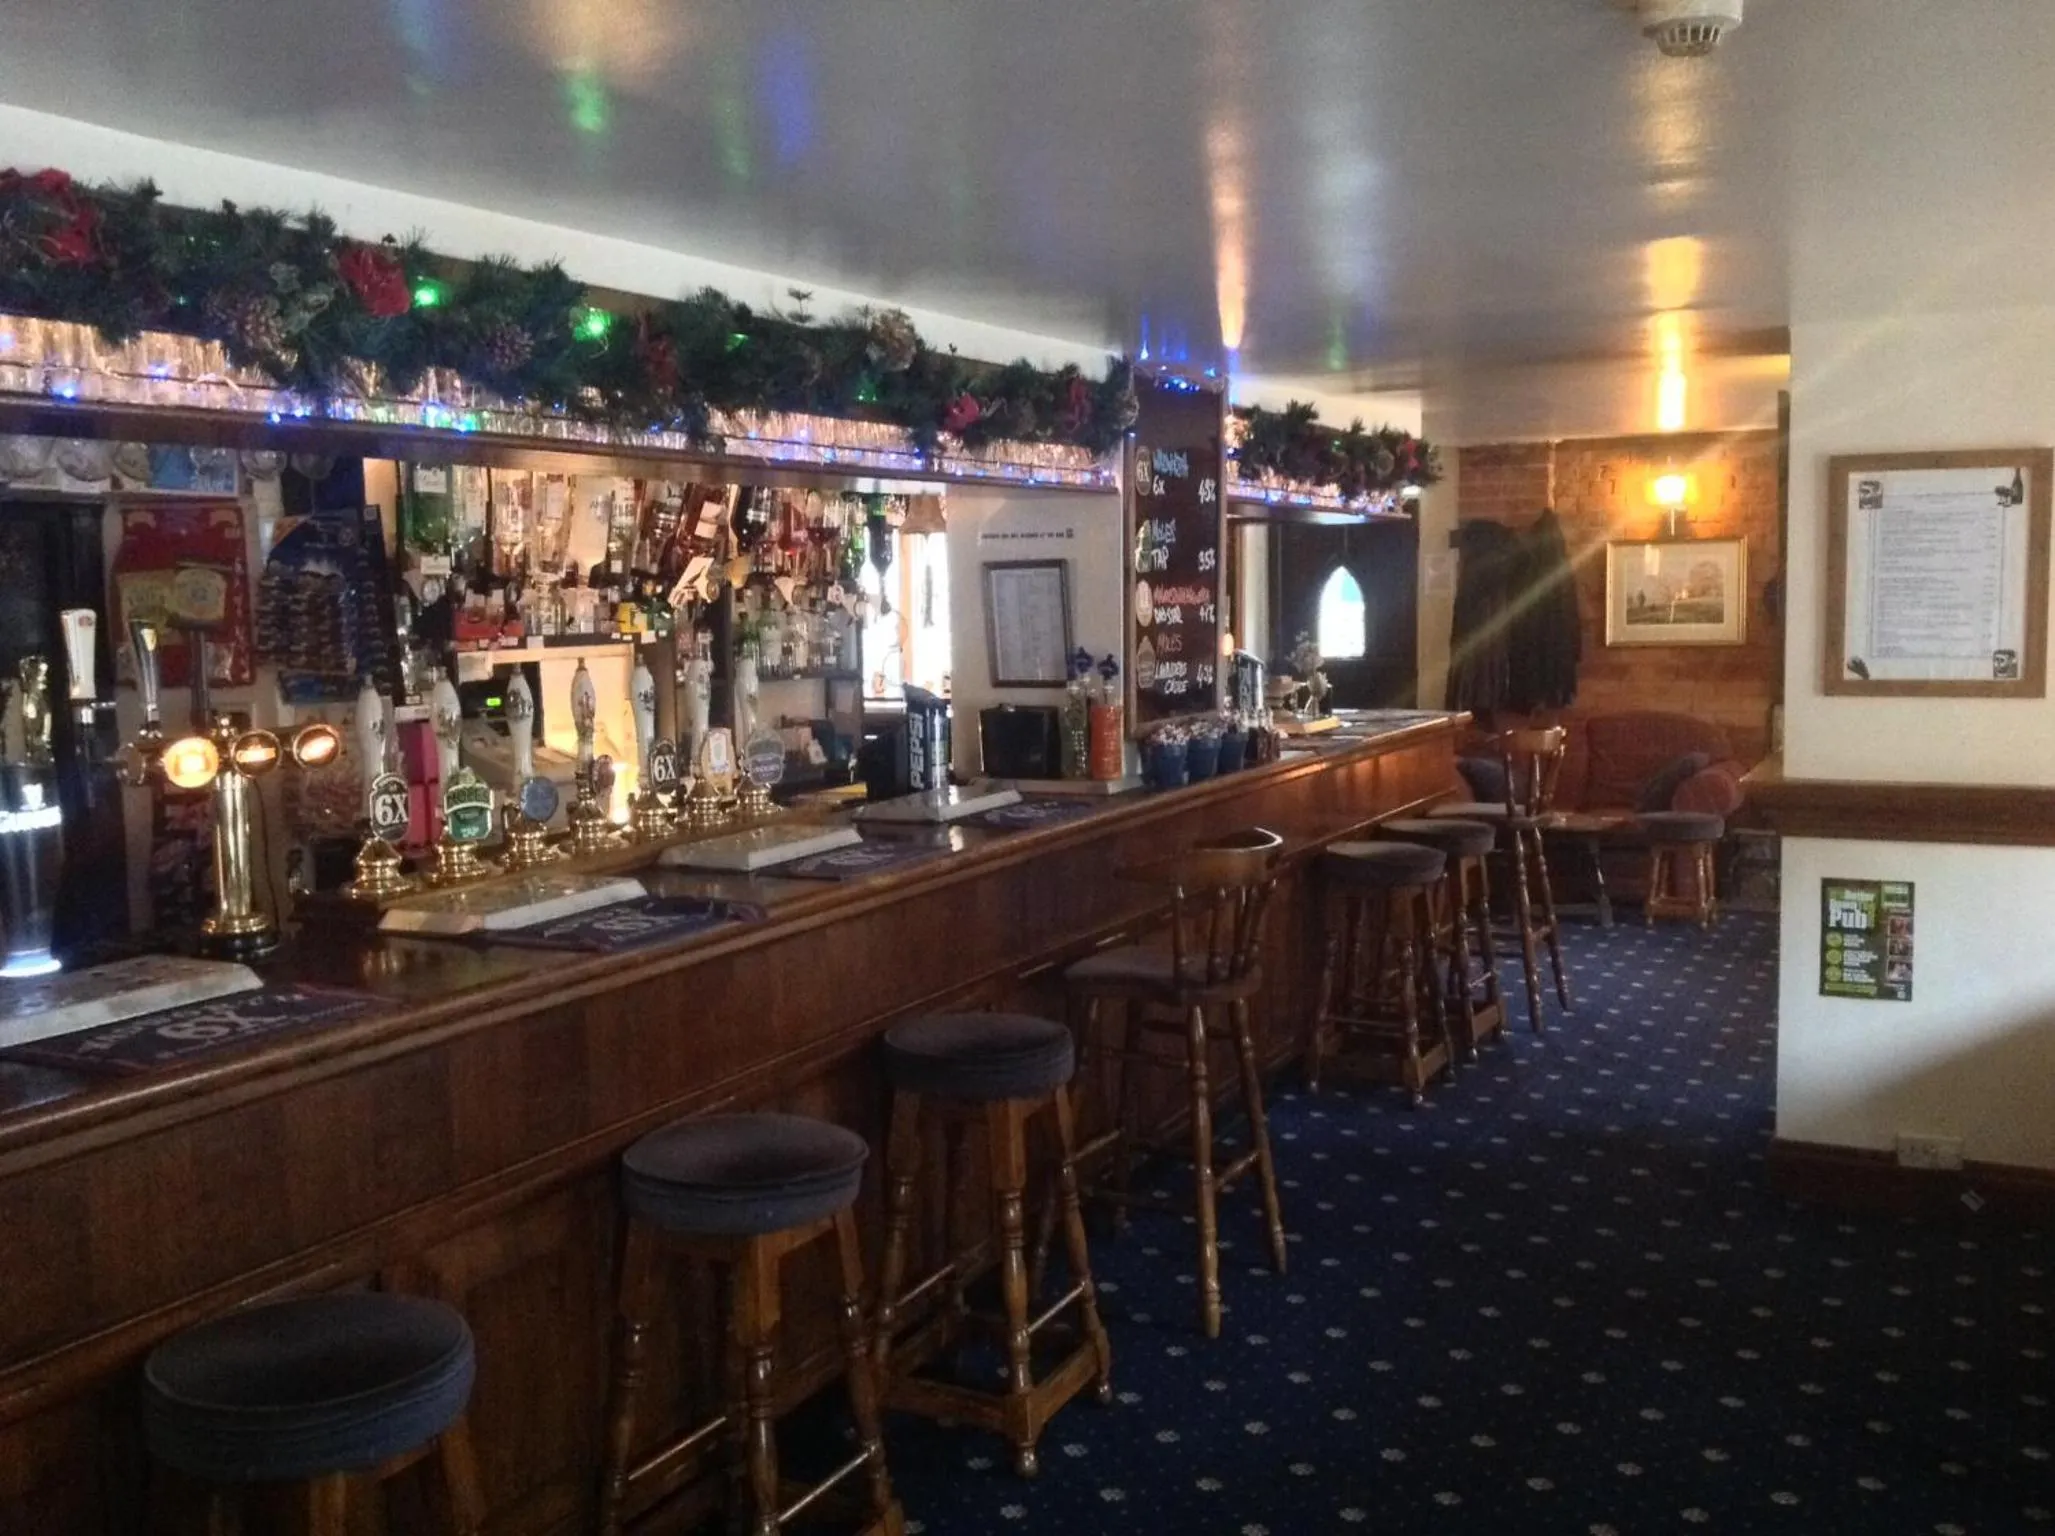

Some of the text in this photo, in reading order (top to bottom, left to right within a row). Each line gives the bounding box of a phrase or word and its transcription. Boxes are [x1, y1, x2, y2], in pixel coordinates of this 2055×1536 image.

[909, 712, 926, 790] PEPSI
[653, 754, 678, 782] 6X
[374, 793, 410, 827] 6X
[1828, 907, 1868, 930] Pub
[156, 1009, 289, 1039] 6X
